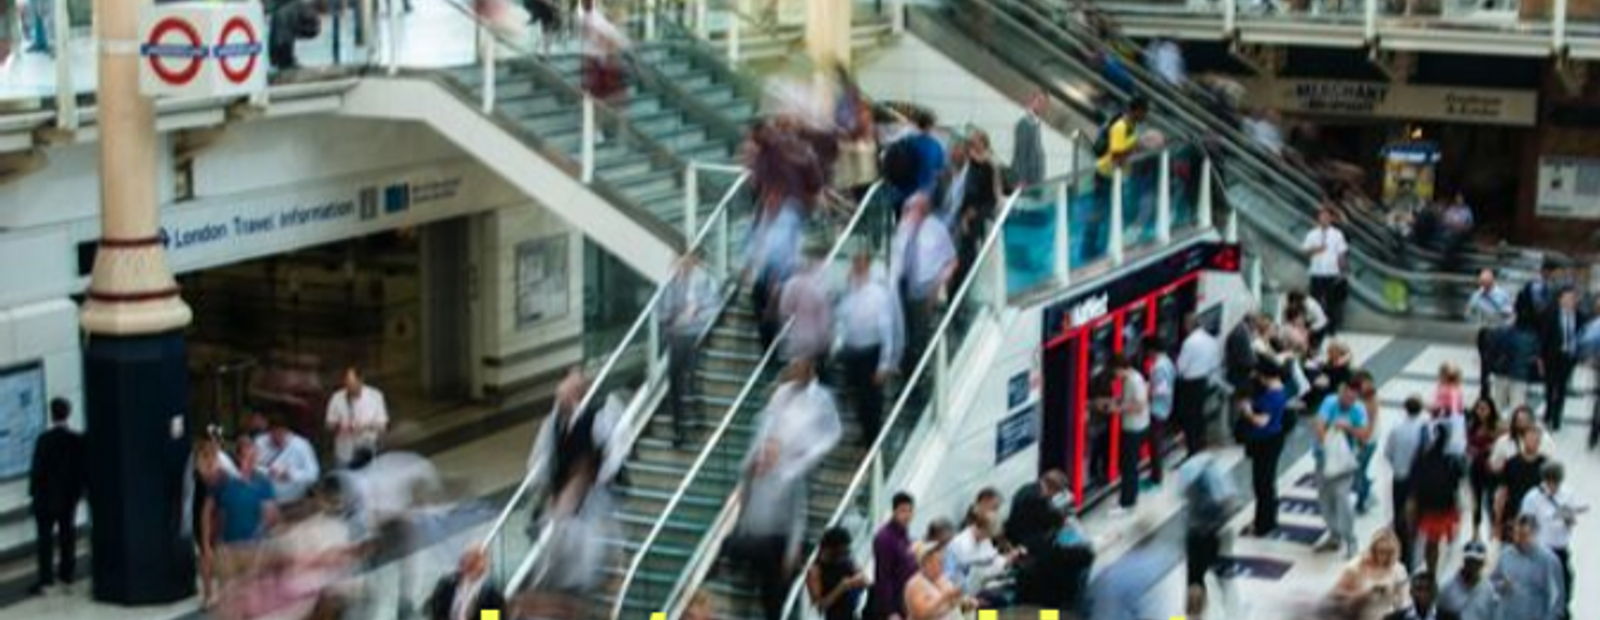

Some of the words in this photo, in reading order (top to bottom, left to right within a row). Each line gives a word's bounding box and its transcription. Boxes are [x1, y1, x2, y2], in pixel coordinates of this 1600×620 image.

[174, 222, 228, 248] London
[234, 213, 275, 236] Travel
[281, 200, 355, 228] Information
